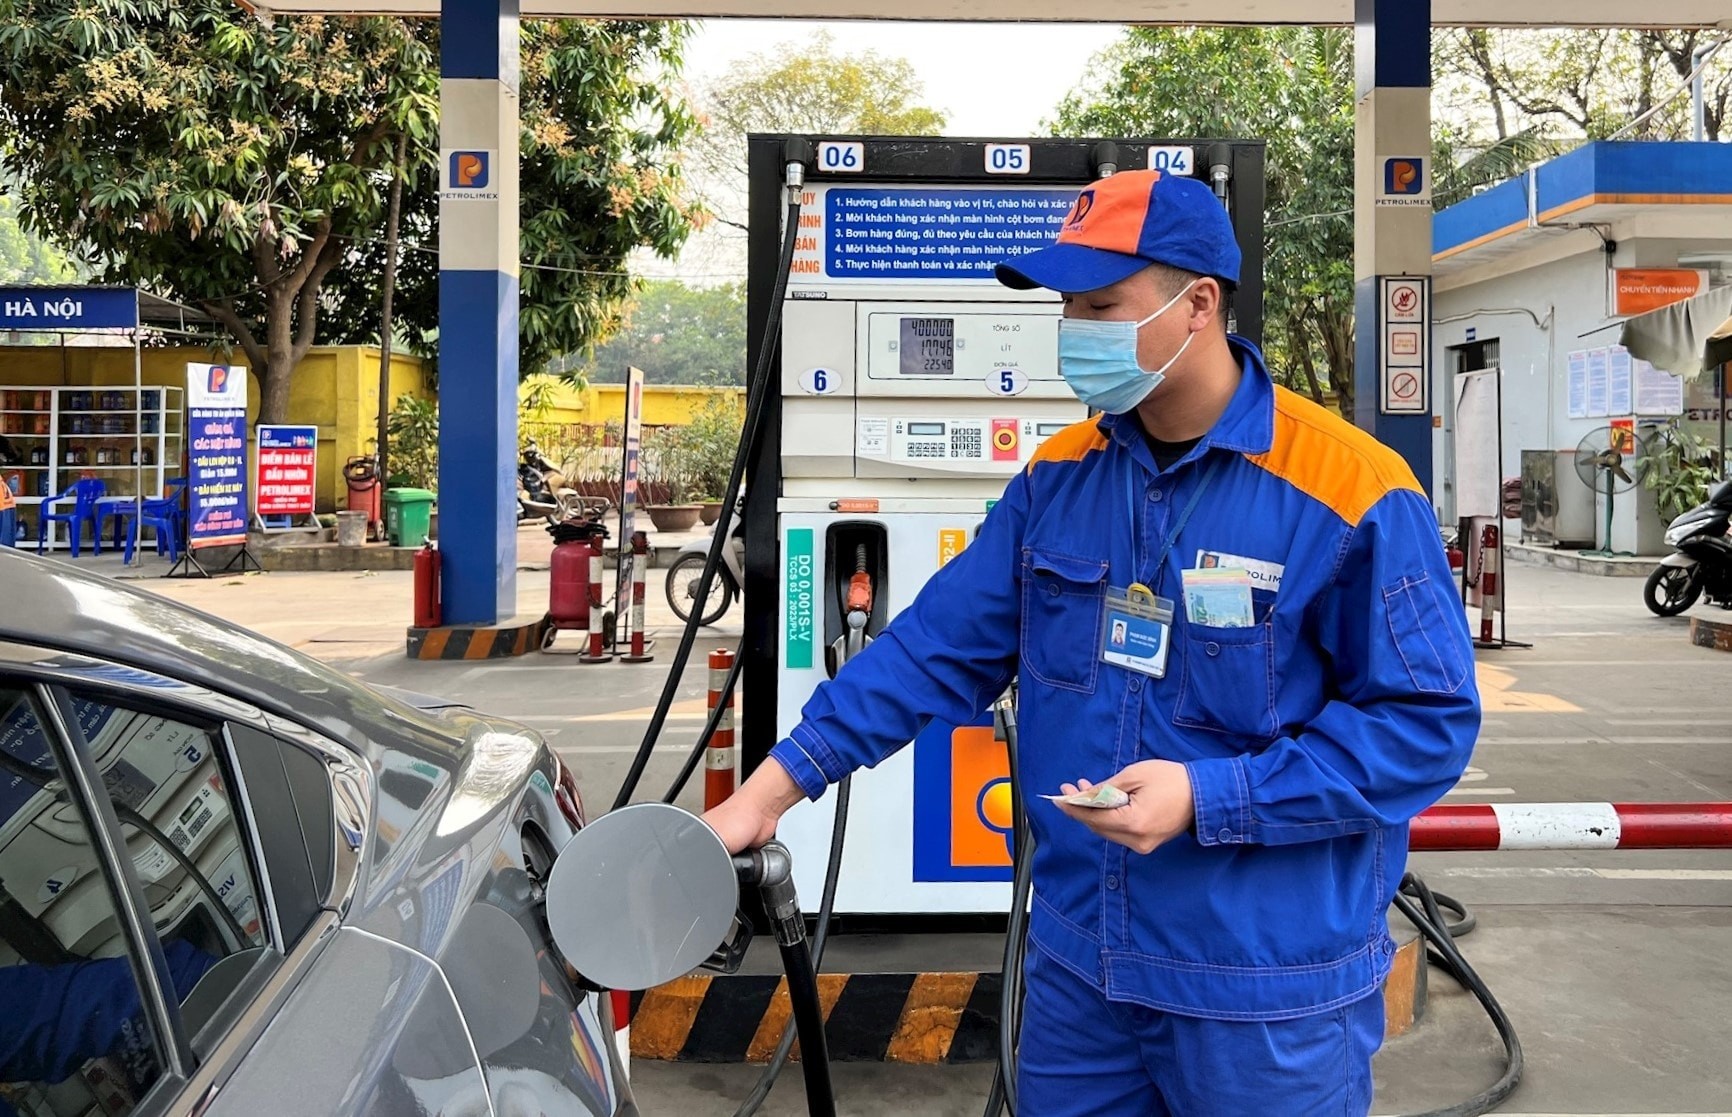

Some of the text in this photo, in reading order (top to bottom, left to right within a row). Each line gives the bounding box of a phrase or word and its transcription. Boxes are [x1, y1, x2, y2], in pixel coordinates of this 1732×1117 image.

[825, 147, 856, 167] 06
[992, 148, 1023, 169] 05
[1155, 150, 1186, 171] 04
[801, 192, 816, 206] UY
[835, 197, 844, 206] 1.
[879, 196, 897, 207] dẫn
[899, 198, 927, 208] khách
[928, 198, 952, 210] hàng
[953, 198, 971, 208] vào
[972, 199, 981, 210] vị
[996, 198, 1020, 208] chào
[1021, 198, 1036, 208] hỏi
[1037, 198, 1049, 209] và
[1050, 198, 1067, 209] xác
[798, 212, 821, 228] RÌNH
[835, 213, 844, 222] 2.
[845, 213, 864, 222] Mời
[865, 213, 893, 223] khách
[895, 213, 918, 225] hàng
[919, 214, 936, 223] xác
[937, 214, 961, 225] nhận
[962, 214, 983, 224] màn
[984, 214, 1005, 223] hình
[1006, 214, 1022, 225] cột
[1023, 214, 1045, 224] bơm
[835, 228, 1061, 241] 3. Bơm hàng đúng, đủ theo yêu cầu của khách hàn
[835, 244, 844, 253] 4.
[845, 244, 863, 253] Mời
[865, 244, 893, 254] khách
[895, 244, 918, 256] hàng
[919, 245, 936, 254] xác
[938, 245, 961, 256] nhận
[962, 245, 983, 254] màn
[984, 245, 1005, 254] hình
[1006, 245, 1022, 257] cột
[791, 257, 820, 273] HÀNG
[835, 259, 844, 269] 5.
[845, 259, 870, 270] Thực
[871, 259, 892, 271] hiện
[893, 260, 920, 269] thanh
[921, 260, 942, 269] toán
[943, 260, 955, 269] và
[956, 260, 973, 270] xác
[5, 297, 82, 320] HÀ NỘI
[912, 320, 953, 336] 400000
[1000, 344, 1012, 352] LÍT
[924, 359, 952, 370] 22540
[814, 369, 827, 392] 6
[1000, 371, 1014, 393] 5
[260, 484, 311, 496] PETROLIMEX
[789, 555, 798, 580] TCCS
[789, 582, 798, 593] 03
[796, 554, 811, 641] DO 0,001S-V
